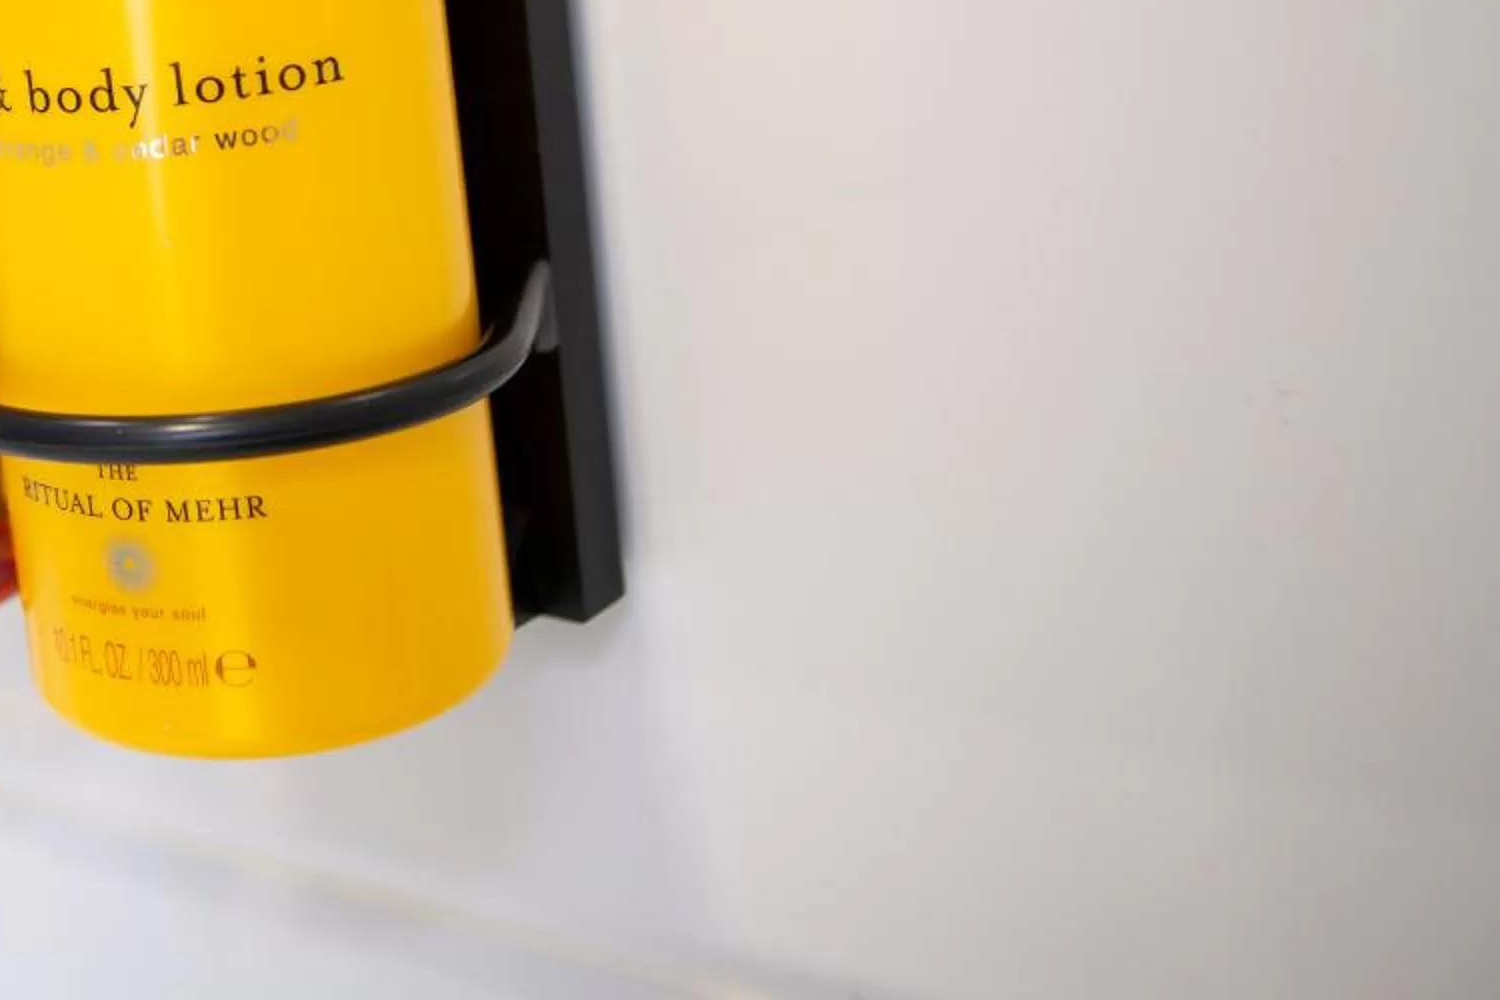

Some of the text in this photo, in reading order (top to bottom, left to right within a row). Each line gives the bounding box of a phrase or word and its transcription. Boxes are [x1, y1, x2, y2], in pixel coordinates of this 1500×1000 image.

[24, 67, 148, 128] body
[169, 53, 345, 107] lotion
[22, 475, 269, 523] RITUAL OF MEHR
[148, 647, 184, 687] 300
[186, 650, 210, 688] ml
